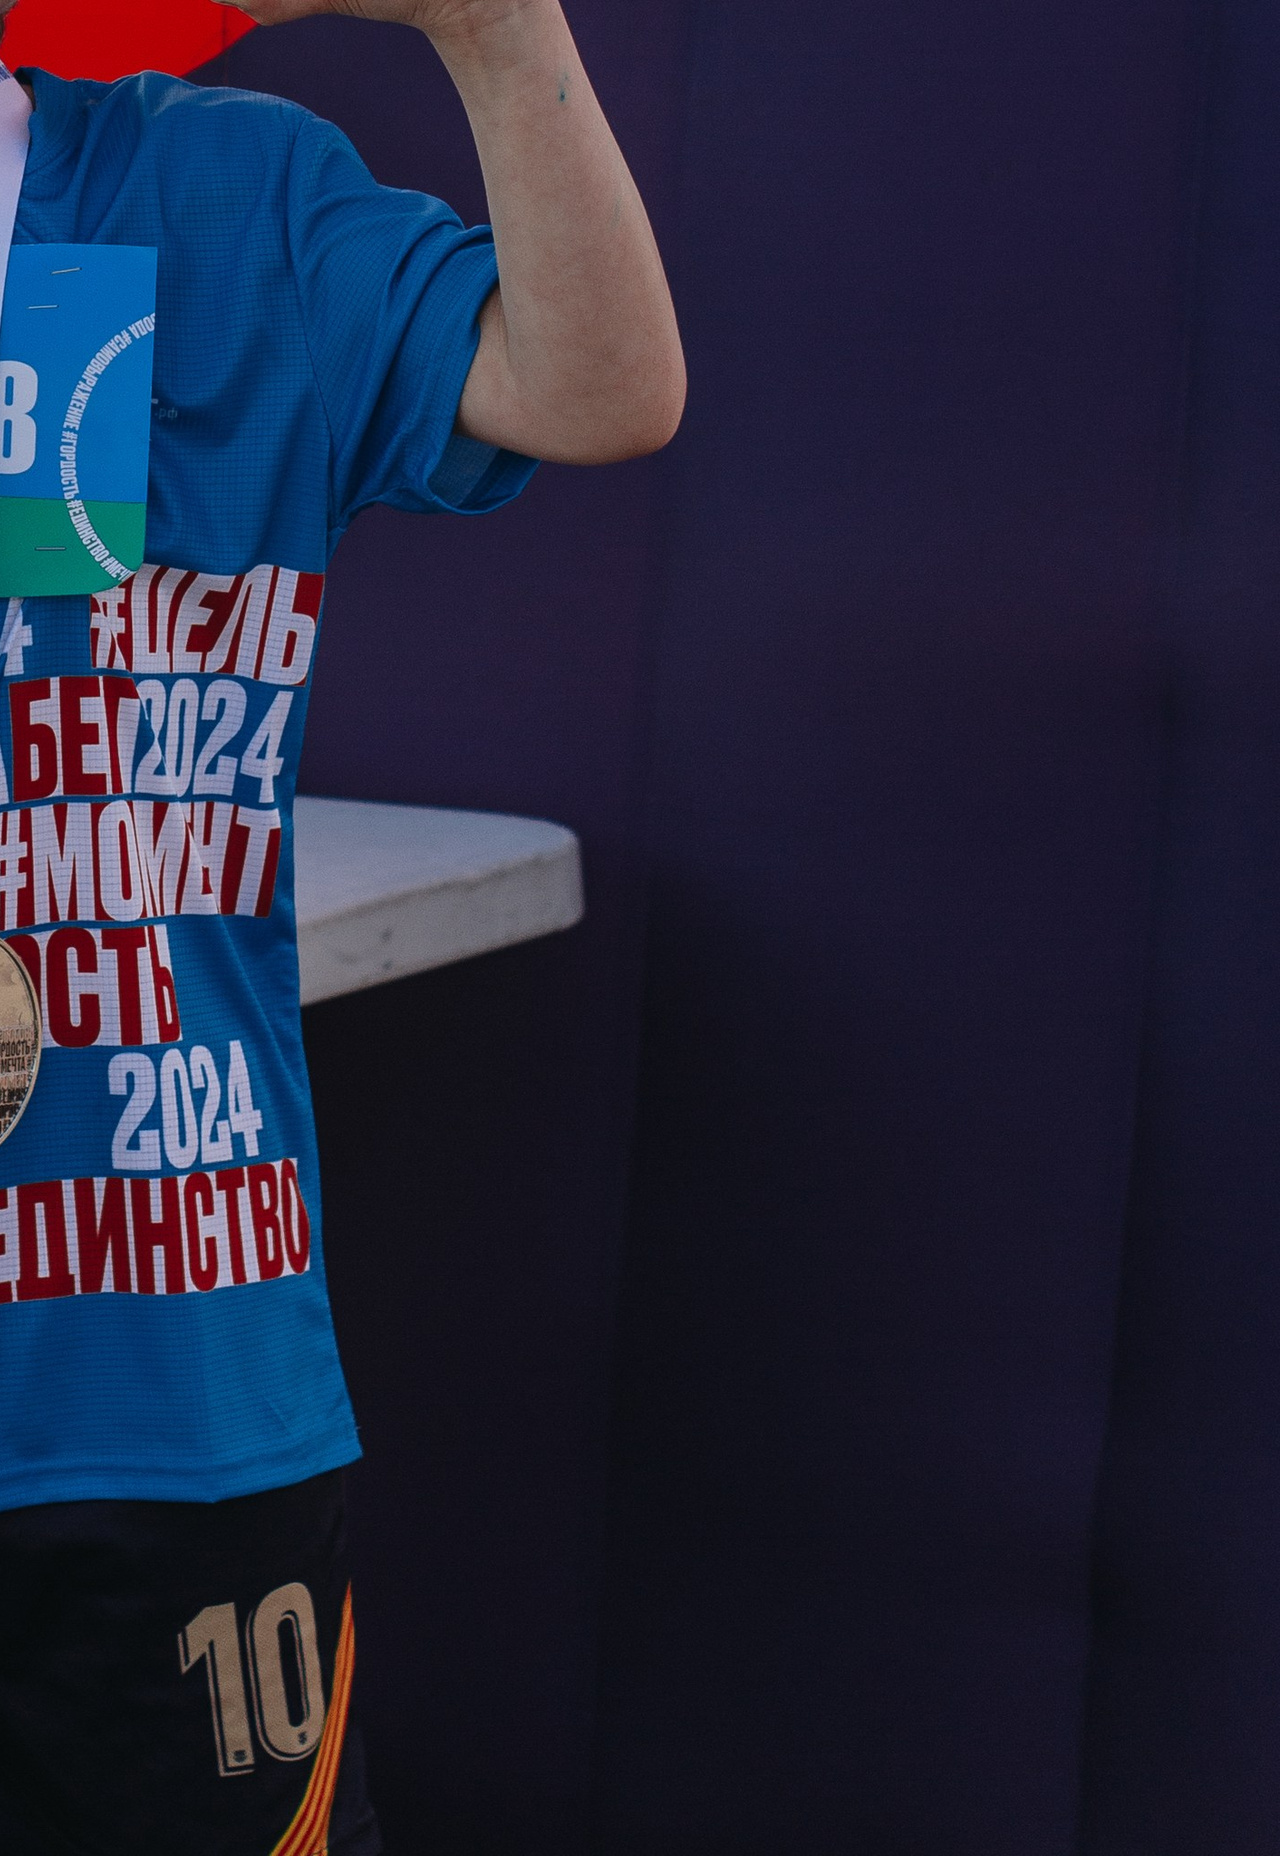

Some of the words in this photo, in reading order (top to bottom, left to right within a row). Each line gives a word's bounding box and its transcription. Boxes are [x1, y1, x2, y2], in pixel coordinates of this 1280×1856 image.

[63, 329, 133, 431] #САМОВЫРАЖЕНИЕ
[60, 431, 80, 500] #ГОРДОСТЬ
[66, 499, 111, 563] #ЕДИНСТВО
[100, 556, 131, 582] #МЕЧ
[134, 678, 295, 804] 2024
[107, 1039, 263, 1171] 2024
[177, 1582, 325, 1777] 10
